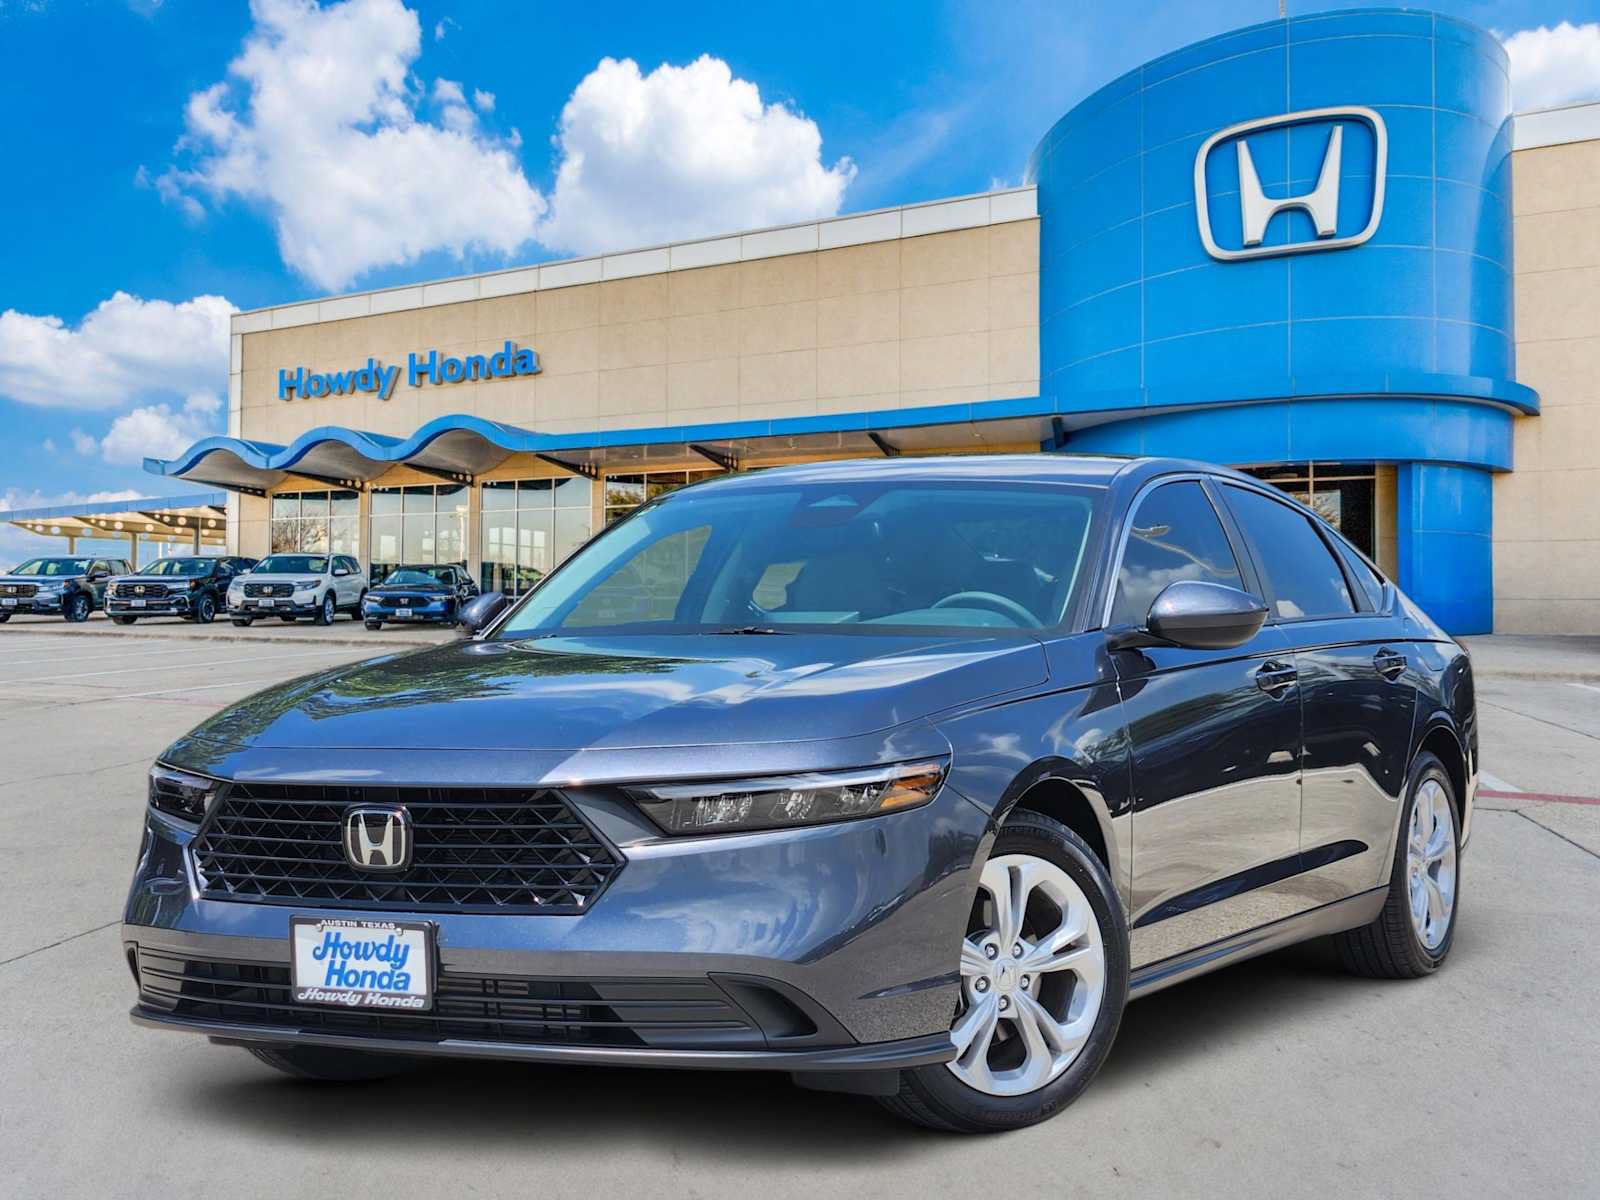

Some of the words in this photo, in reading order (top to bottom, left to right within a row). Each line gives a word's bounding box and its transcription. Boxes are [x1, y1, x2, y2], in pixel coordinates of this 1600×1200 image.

[278, 358, 401, 401] Howdy
[408, 340, 542, 387] Honda
[320, 919, 358, 928] AUSTIN
[360, 921, 396, 930] TEXAS
[312, 931, 410, 969] Howdy
[324, 960, 412, 991] Honda
[297, 988, 362, 1006] Howdy
[364, 992, 425, 1008] Honda
